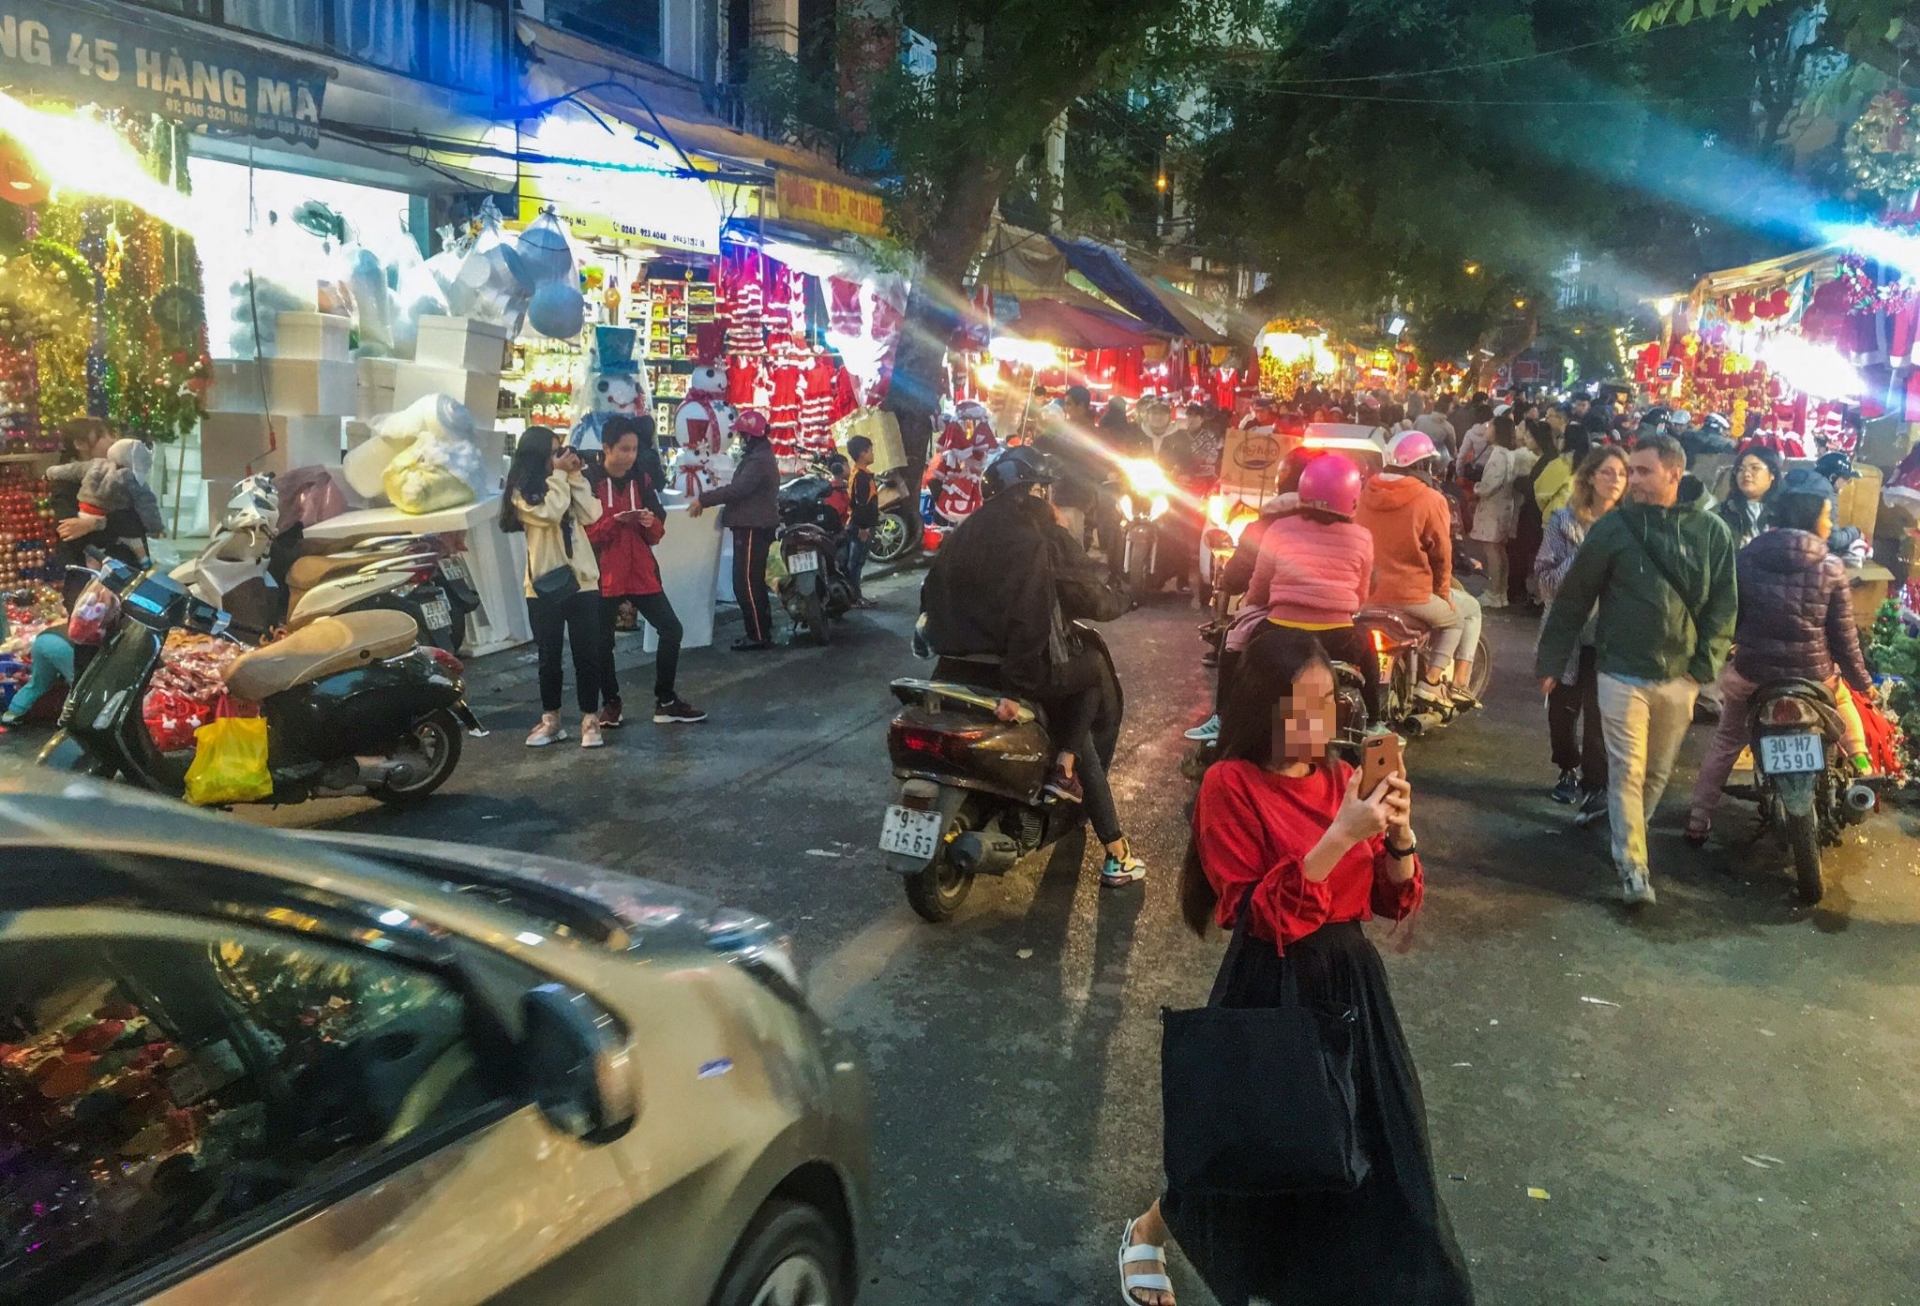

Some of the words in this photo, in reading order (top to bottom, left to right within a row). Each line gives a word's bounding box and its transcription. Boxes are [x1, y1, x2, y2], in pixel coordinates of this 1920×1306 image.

[66, 33, 120, 81] 45
[135, 46, 248, 109] HÀNG
[257, 76, 319, 124] MÃ
[1769, 736, 1812, 754] 30-H7
[1772, 753, 1816, 771] 2590
